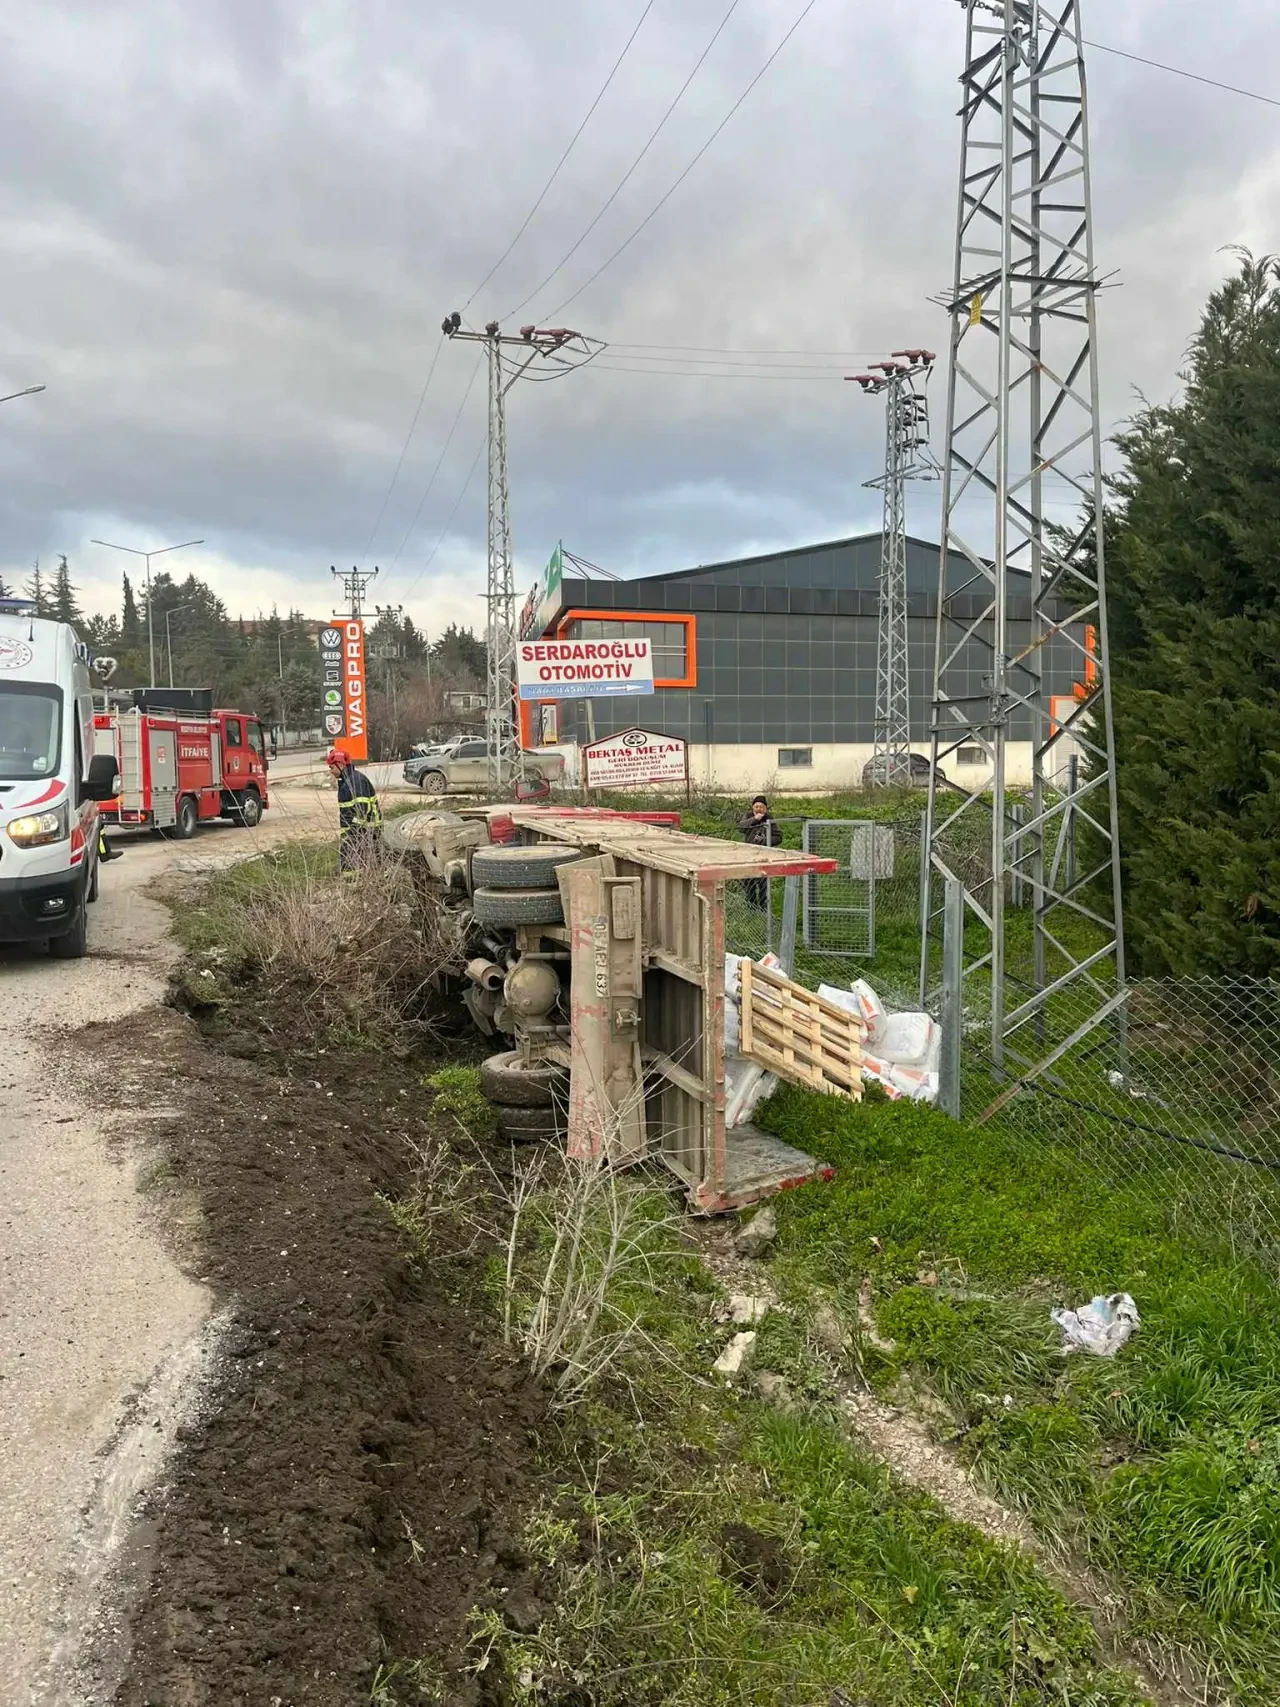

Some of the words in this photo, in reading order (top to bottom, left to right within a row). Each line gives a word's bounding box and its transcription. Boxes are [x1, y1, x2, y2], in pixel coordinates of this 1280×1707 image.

[522, 641, 647, 661] SERDAROĞLU
[346, 622, 364, 737] WAGPRO
[539, 660, 633, 681] OTOMOTİV
[181, 745, 209, 757] İTFAİYE
[588, 748, 632, 759] BEKTAŞ
[636, 743, 683, 755] METAL
[596, 973, 608, 996] 637
